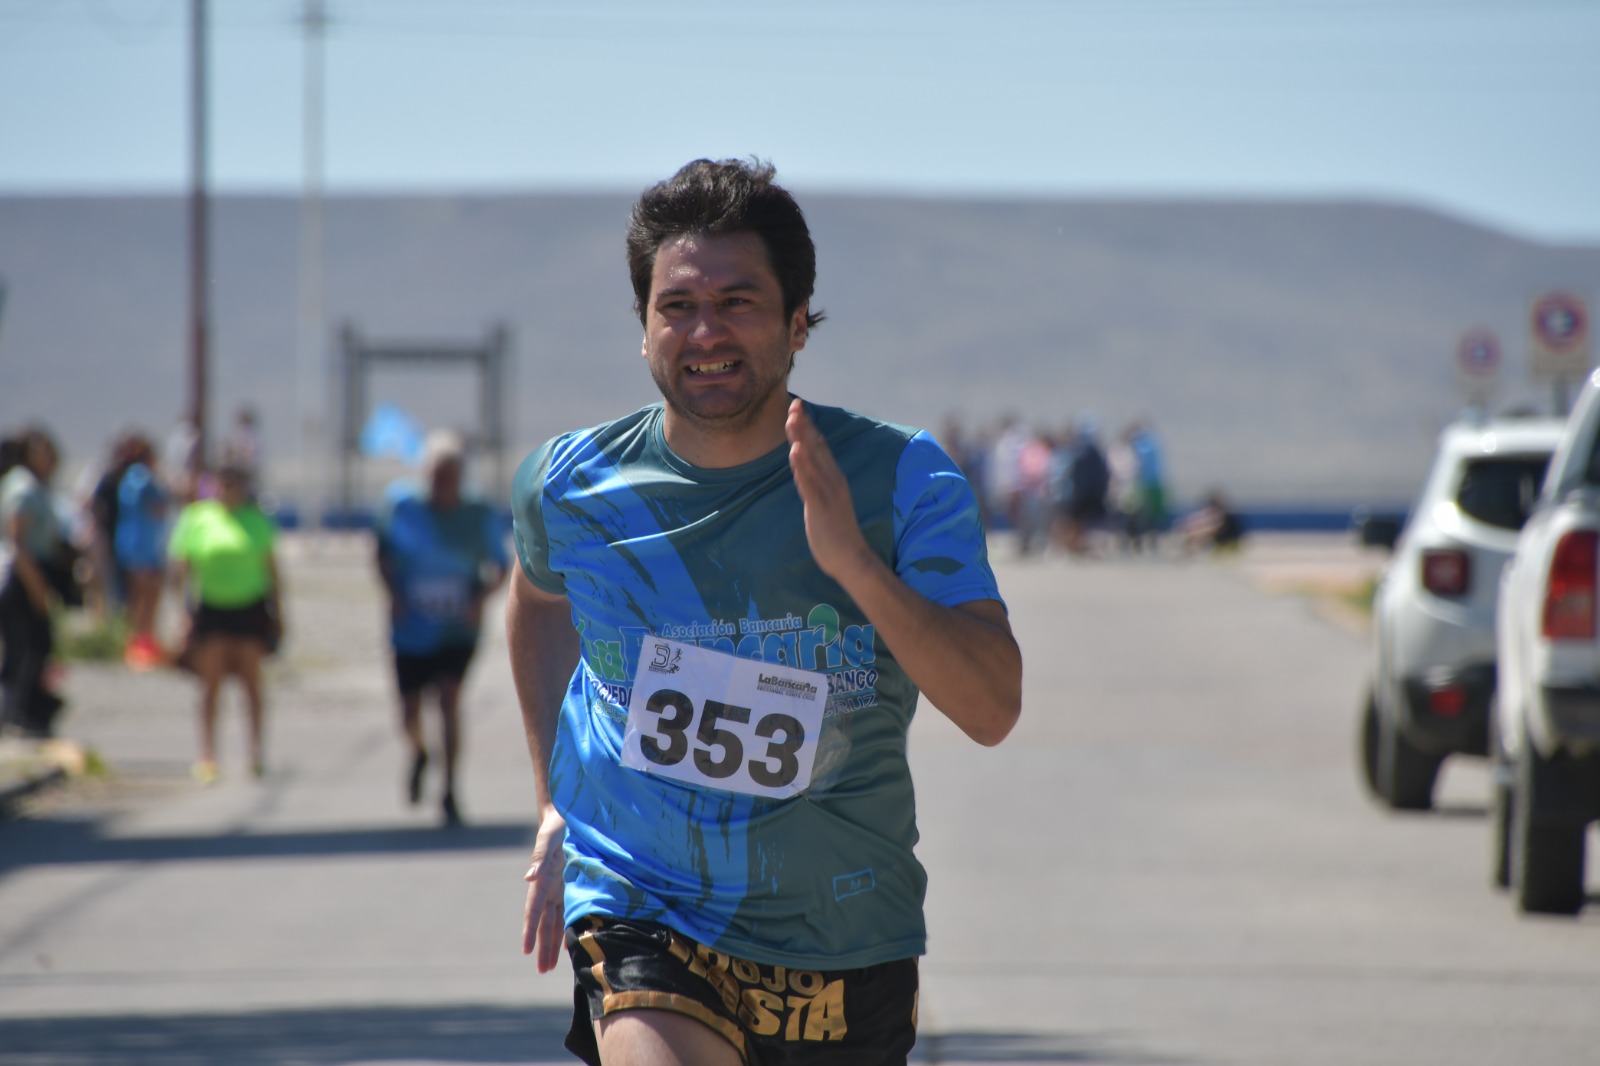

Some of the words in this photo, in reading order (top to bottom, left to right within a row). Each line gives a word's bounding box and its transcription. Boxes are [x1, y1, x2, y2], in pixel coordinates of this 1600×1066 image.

[662, 618, 736, 638] Asociación
[739, 612, 803, 634] Bancaria
[826, 669, 878, 696] BANCO
[640, 688, 805, 788] 353
[697, 943, 824, 997] DOJO
